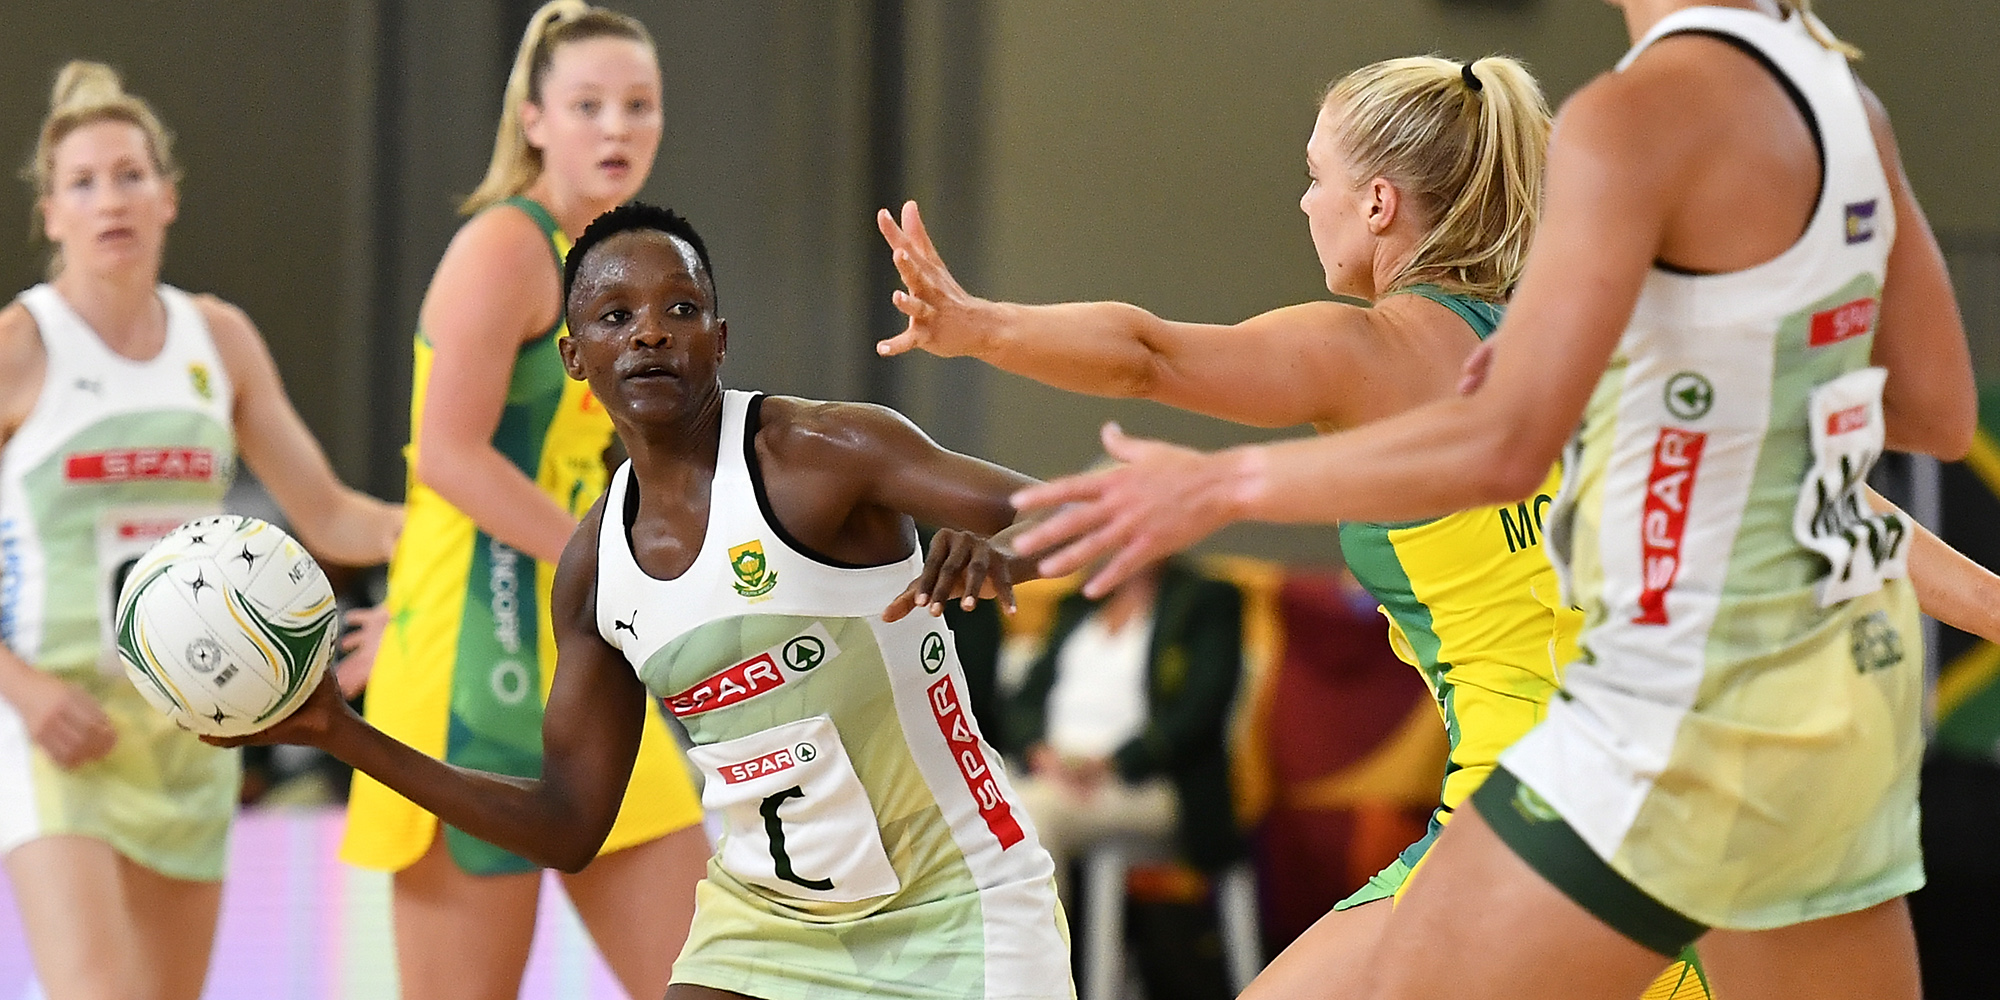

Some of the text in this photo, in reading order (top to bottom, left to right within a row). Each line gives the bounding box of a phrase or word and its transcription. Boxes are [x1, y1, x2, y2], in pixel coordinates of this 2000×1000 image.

[102, 449, 213, 480] SPAR
[1646, 433, 1697, 590] SPAR
[672, 660, 778, 713] SPAR
[731, 751, 793, 781] SPAR
[933, 680, 1003, 810] SPAR
[759, 785, 835, 891] C
